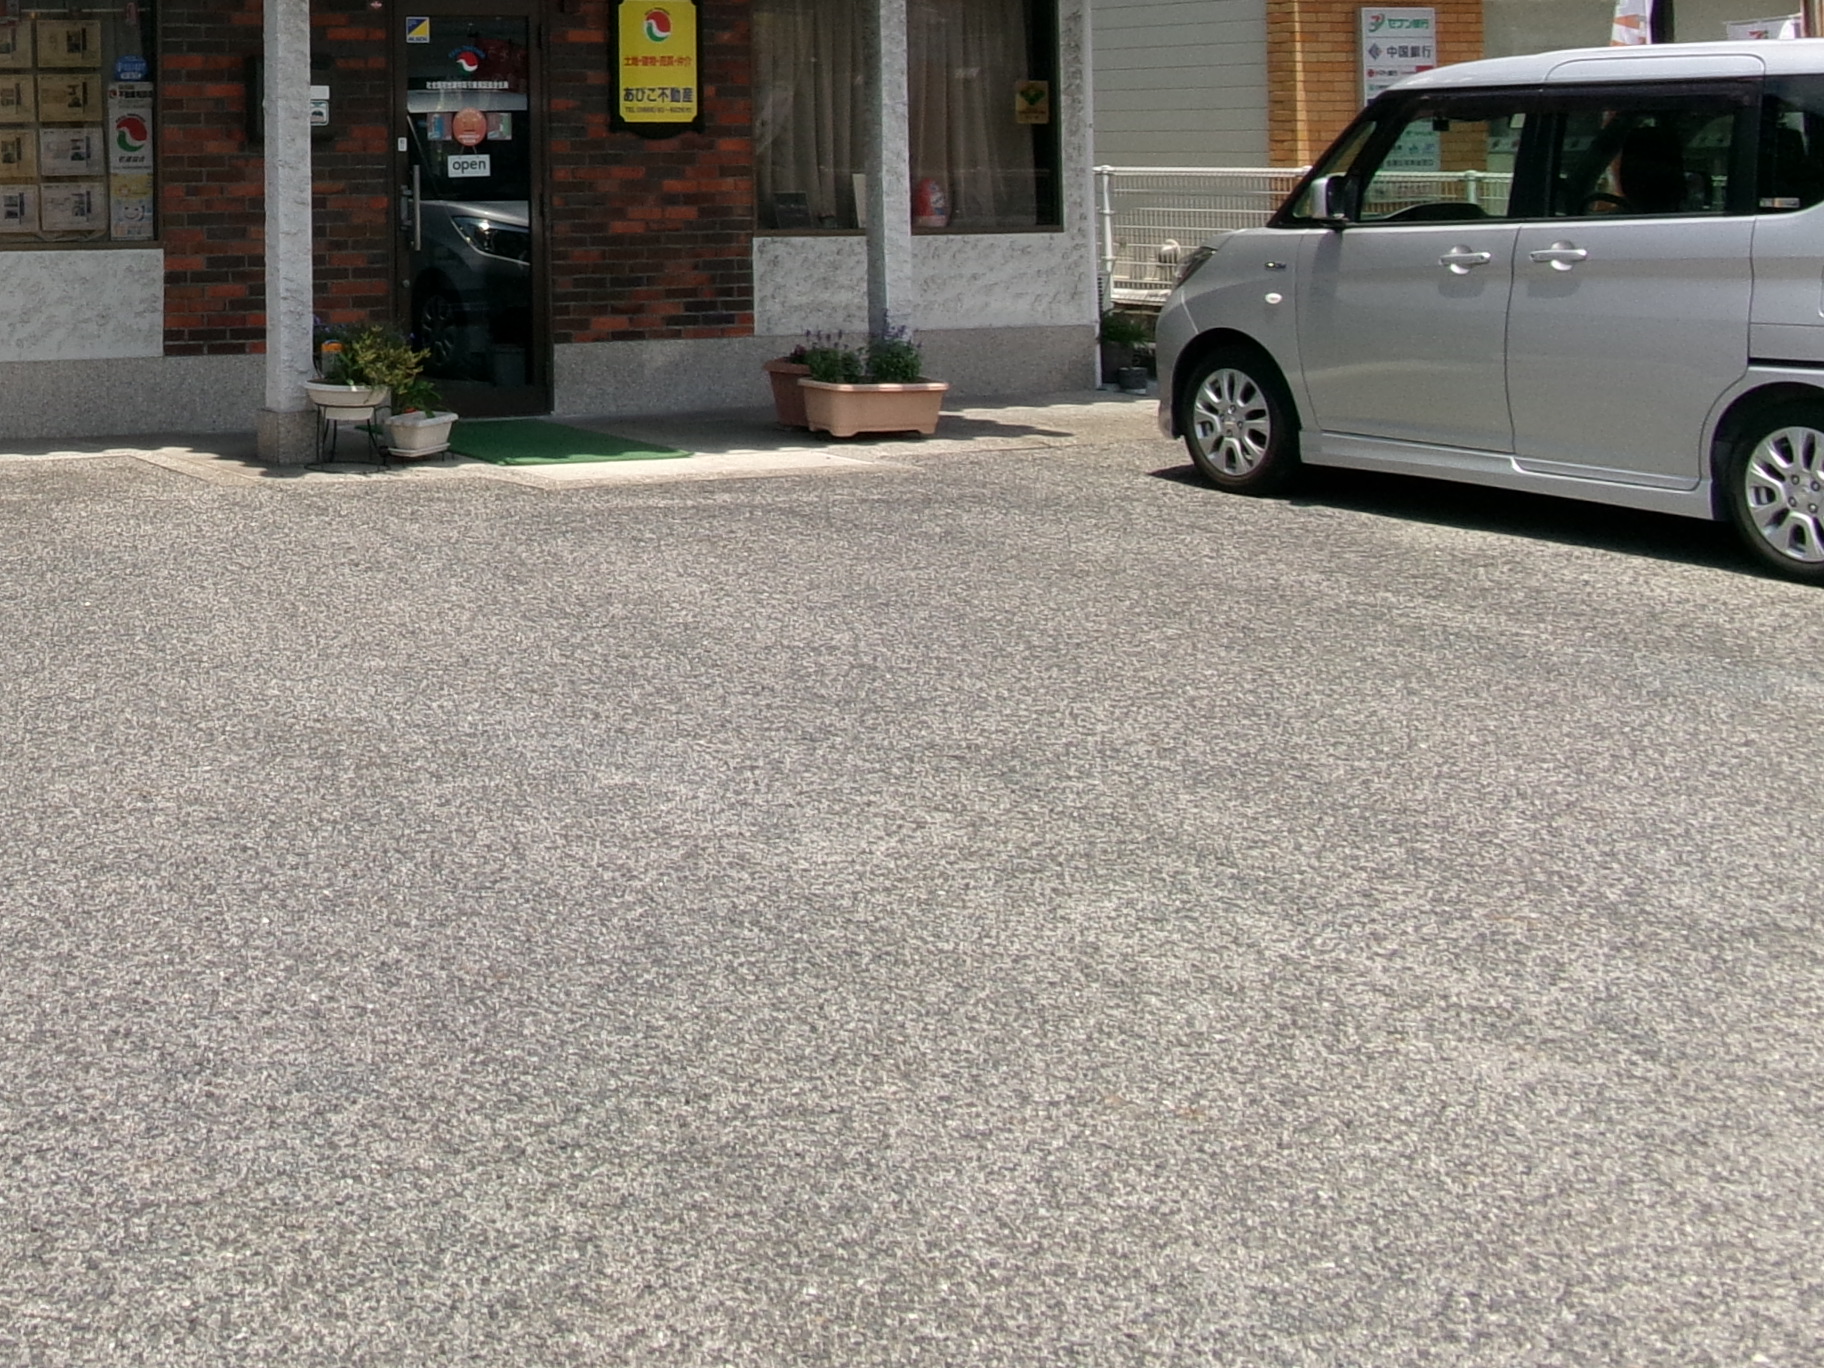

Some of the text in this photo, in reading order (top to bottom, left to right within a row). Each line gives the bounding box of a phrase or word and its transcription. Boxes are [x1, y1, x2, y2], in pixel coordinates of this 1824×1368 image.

[1386, 45, 1433, 59] 中国銀行
[623, 87, 694, 103] あびこ不動産
[452, 159, 487, 175] open
